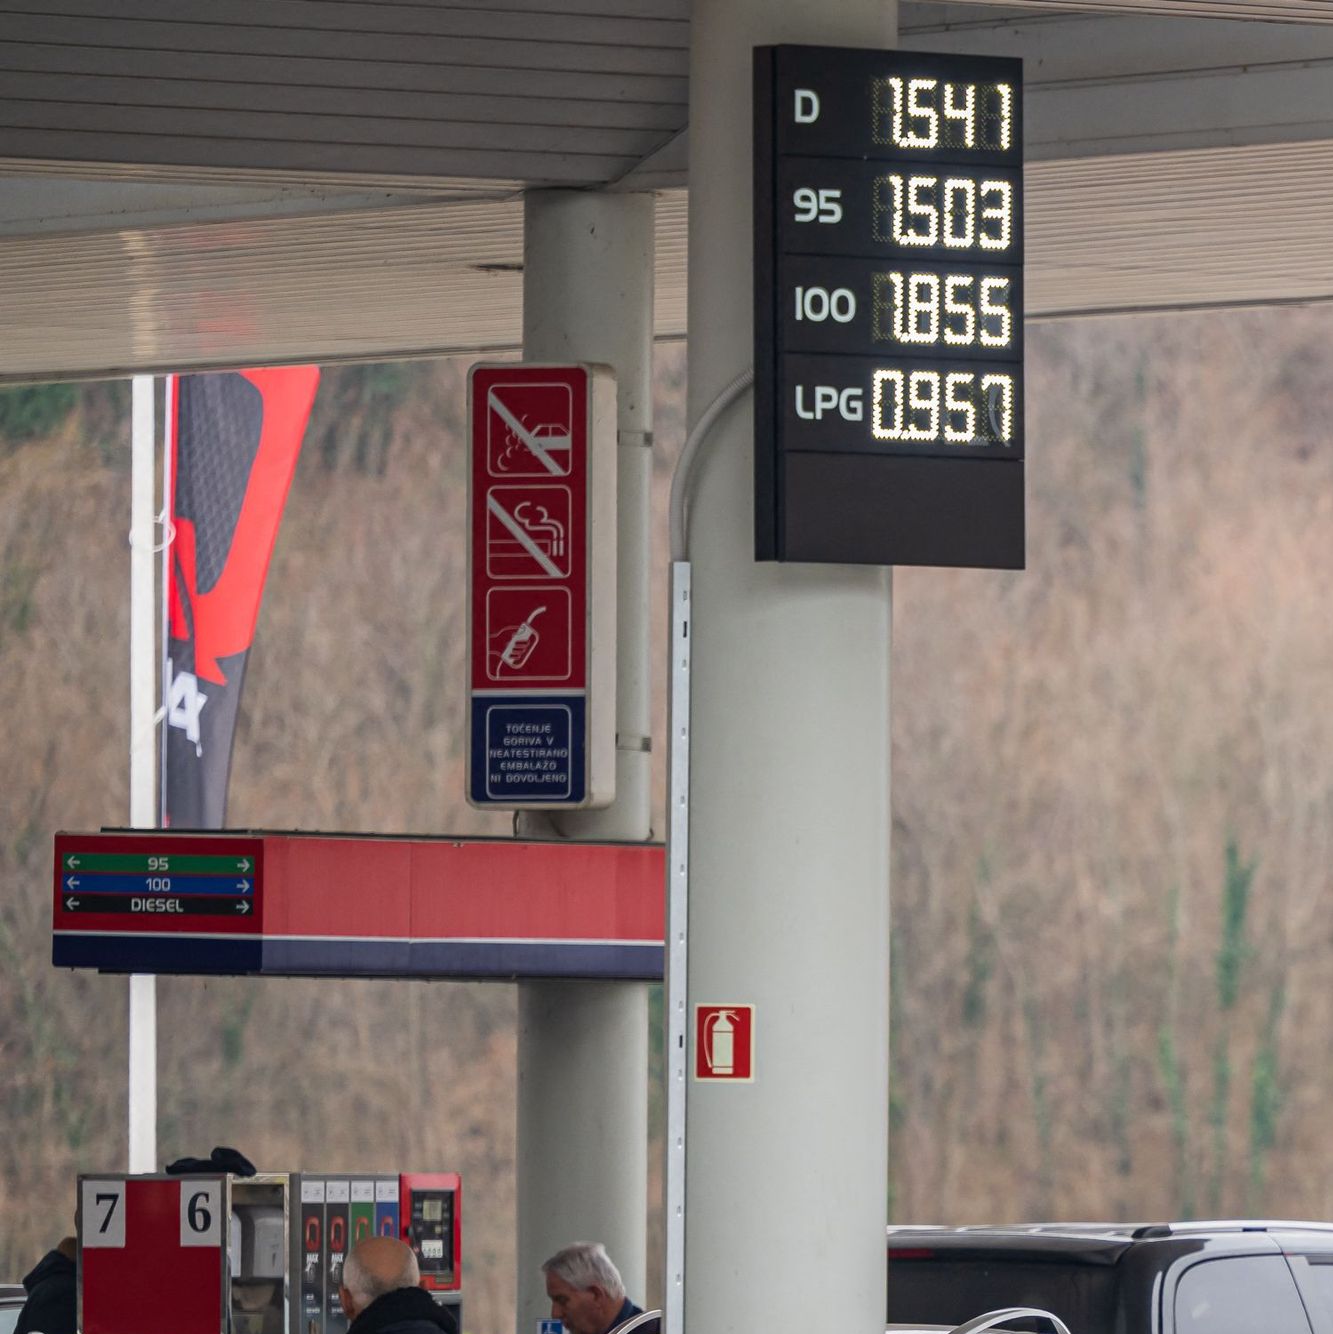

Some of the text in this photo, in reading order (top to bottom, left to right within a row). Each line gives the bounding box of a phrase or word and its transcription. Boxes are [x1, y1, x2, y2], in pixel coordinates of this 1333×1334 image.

[794, 89, 819, 124] D
[794, 188, 842, 223] 95
[794, 287, 856, 323] 100
[794, 386, 863, 421] LPG
[489, 748, 568, 759] NEATESTIRANO
[503, 736, 554, 746] GORIVA V
[506, 773, 567, 783] DOVOLJENO
[148, 857, 169, 871] 95
[146, 878, 171, 892] 100
[131, 898, 184, 913] DIESEL
[96, 1193, 119, 1233] 7
[187, 1191, 212, 1233] 6
